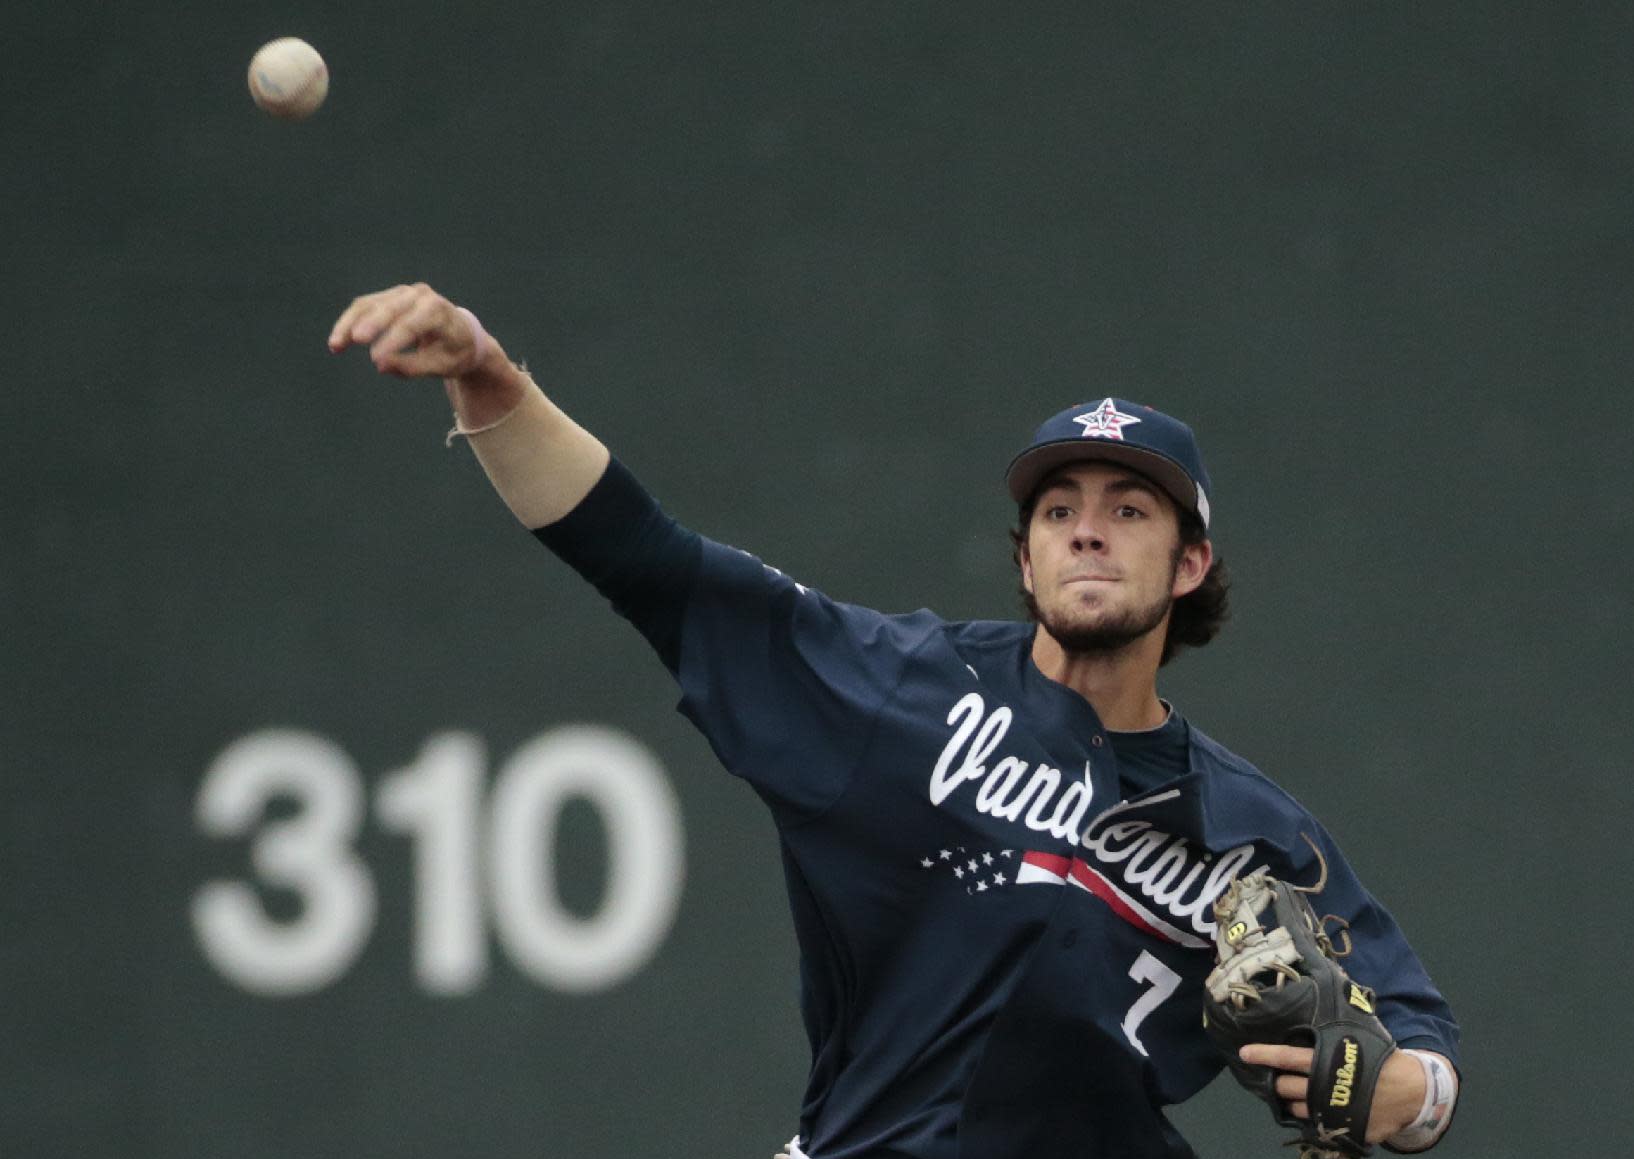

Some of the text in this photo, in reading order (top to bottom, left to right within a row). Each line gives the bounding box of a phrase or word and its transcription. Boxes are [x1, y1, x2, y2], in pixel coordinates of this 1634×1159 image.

[193, 726, 686, 994] 310
[930, 693, 1271, 941] Vanderbil
[1121, 949, 1183, 1057] 7
[1329, 1038, 1359, 1107] Wilson
